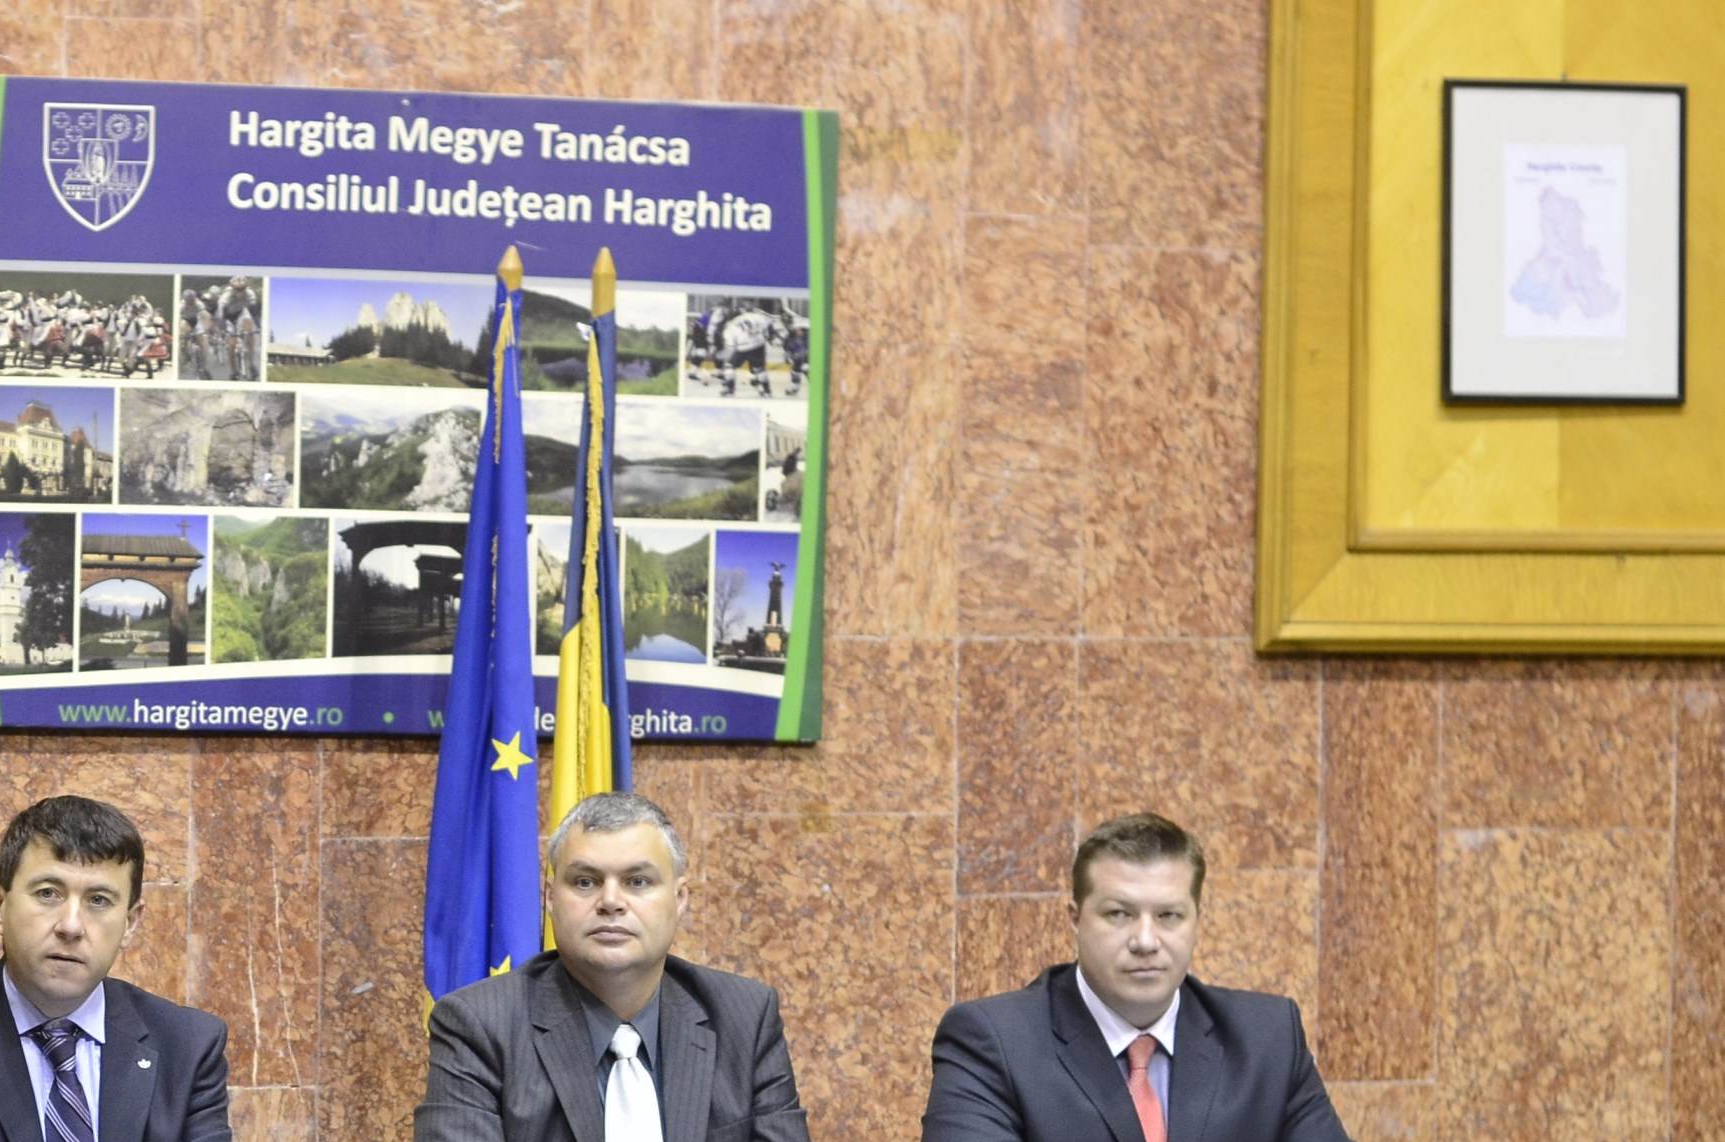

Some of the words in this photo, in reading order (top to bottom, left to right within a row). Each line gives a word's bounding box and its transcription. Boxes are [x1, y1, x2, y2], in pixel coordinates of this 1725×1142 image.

[229, 110, 376, 157] Hargita
[388, 115, 525, 165] Megye
[533, 122, 690, 166] Tanácsa
[227, 172, 399, 213] Consiliul
[604, 188, 772, 236] Harghita
[58, 699, 343, 730] www.hargitamegye.ro
